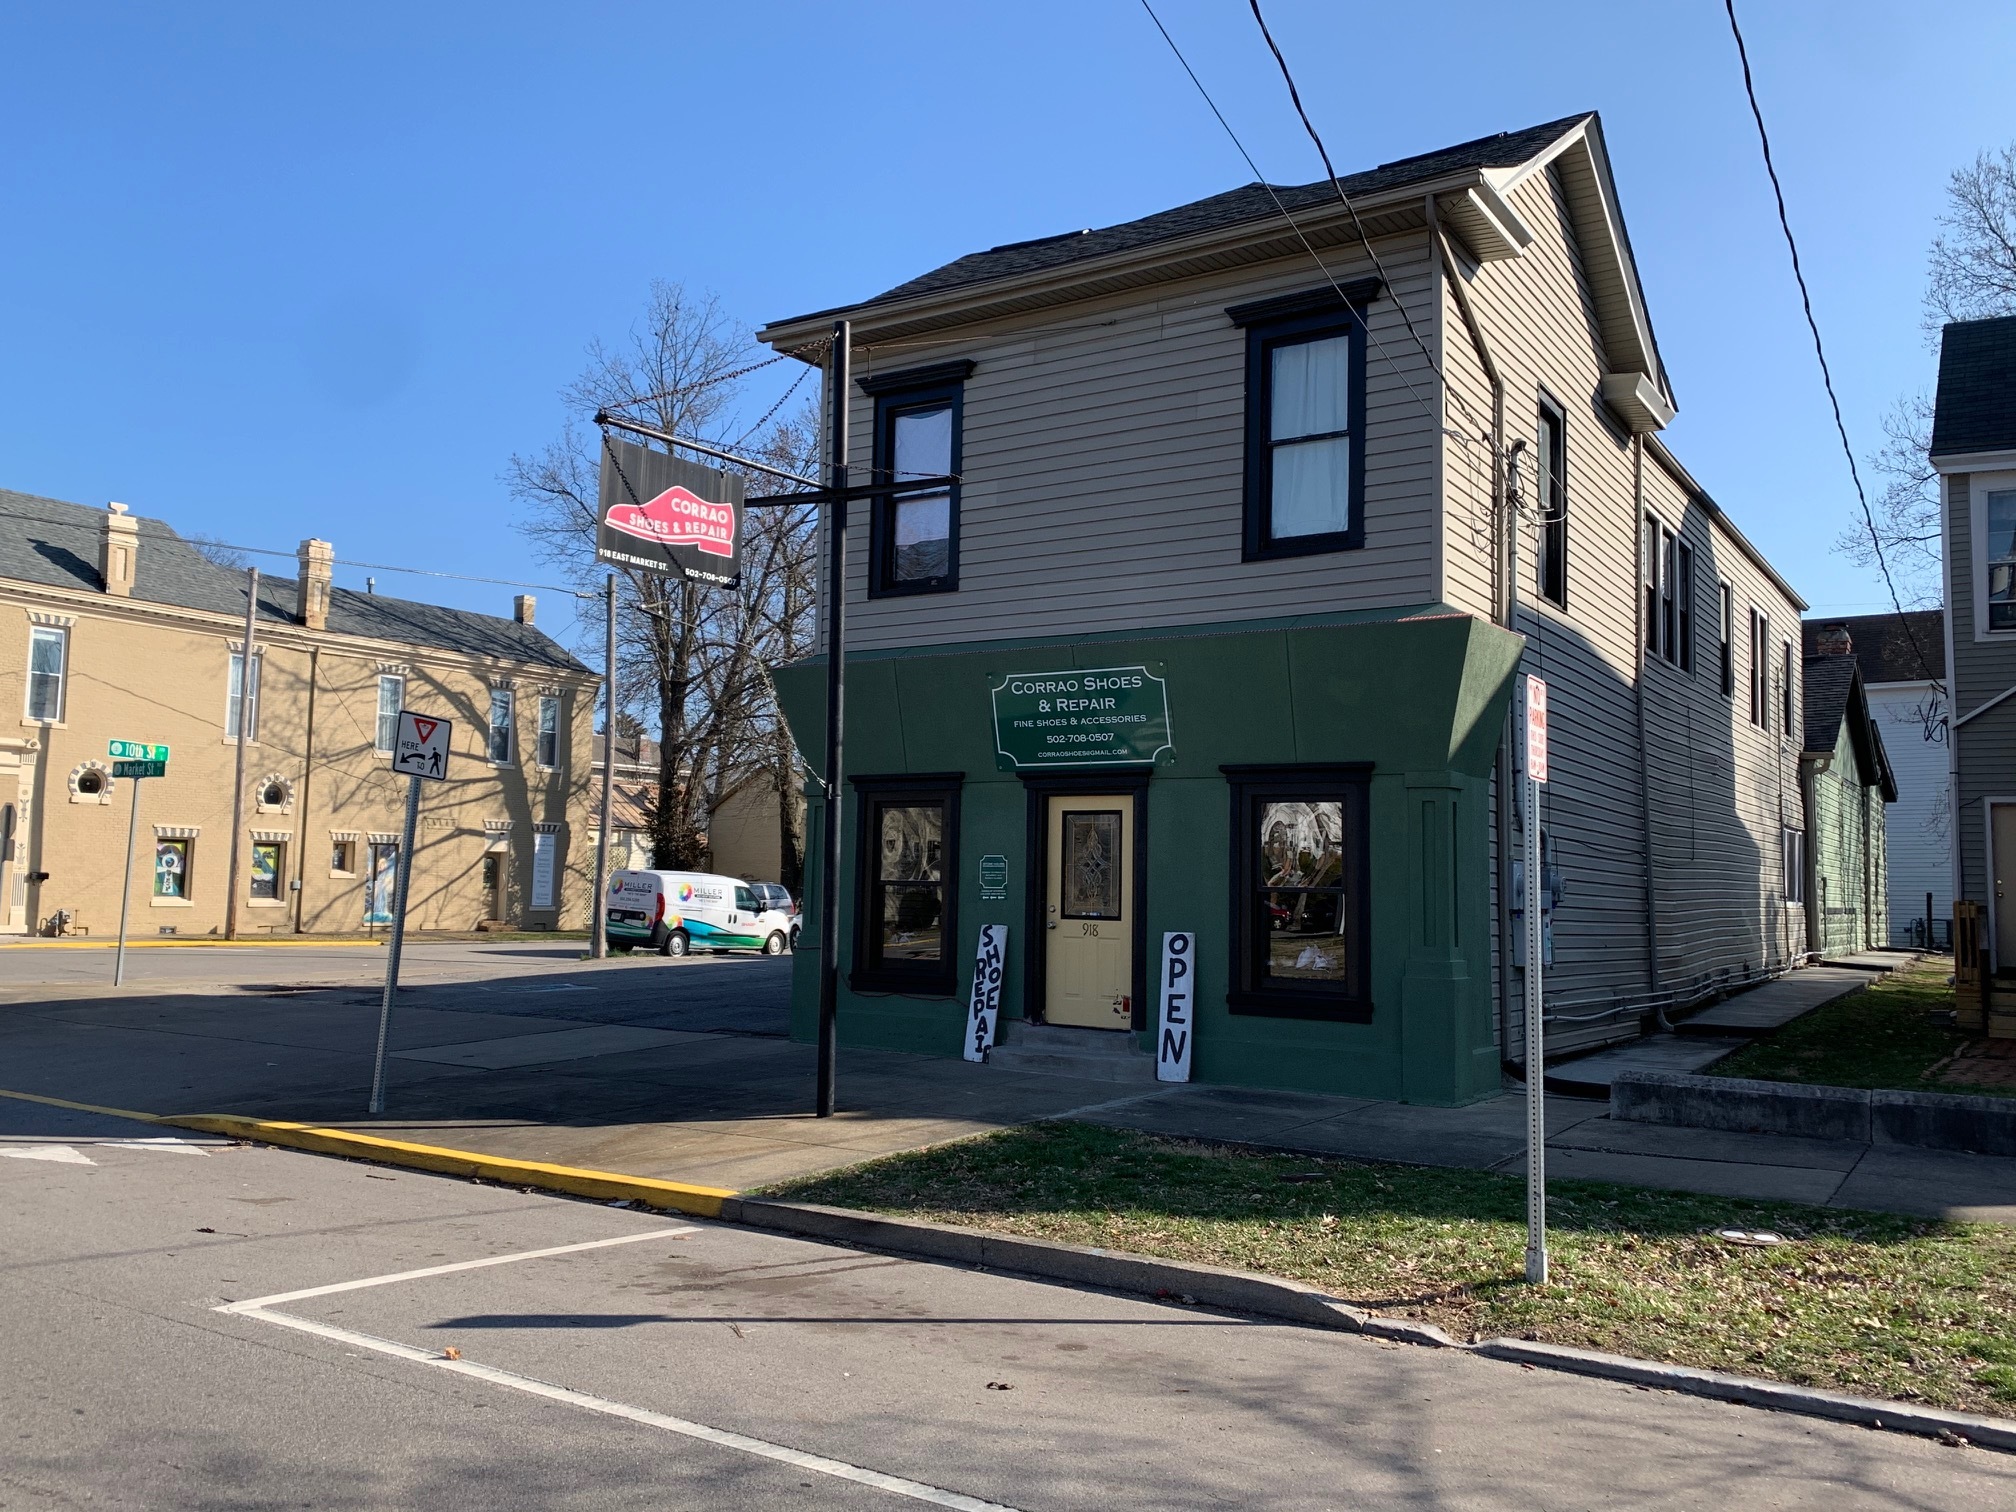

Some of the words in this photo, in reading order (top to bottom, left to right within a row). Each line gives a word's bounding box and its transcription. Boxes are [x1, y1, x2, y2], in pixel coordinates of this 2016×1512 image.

[671, 498, 728, 523] CORRAO
[629, 513, 669, 534] SHOES
[673, 523, 681, 533] &
[685, 521, 727, 539] REPAIR
[598, 548, 611, 558] 918
[612, 552, 629, 563] EAST
[630, 555, 657, 568] MARKET
[658, 561, 669, 571] ST.
[685, 568, 737, 586] 502-708-0507
[1011, 680, 1079, 695] CORRAO
[1084, 675, 1143, 691] SHOES
[1038, 699, 1051, 713] &
[1056, 697, 1116, 712] REPAIR
[1014, 720, 1034, 728] FINE
[1036, 718, 1067, 727] SHOES
[1070, 717, 1078, 726] &
[1080, 714, 1147, 725] ACCESSORIES
[401, 740, 420, 751] HERE
[1046, 733, 1115, 744] 502-708-0507
[125, 743, 144, 758] 10th
[146, 745, 156, 760] St
[123, 762, 145, 776] Market
[146, 762, 155, 775] St
[417, 761, 425, 770] TO
[624, 881, 653, 889] MILLER
[694, 887, 723, 895] MILLER
[1082, 922, 1099, 937] 918
[982, 924, 1001, 1010] SHOE
[1161, 933, 1189, 1064] OPEN
